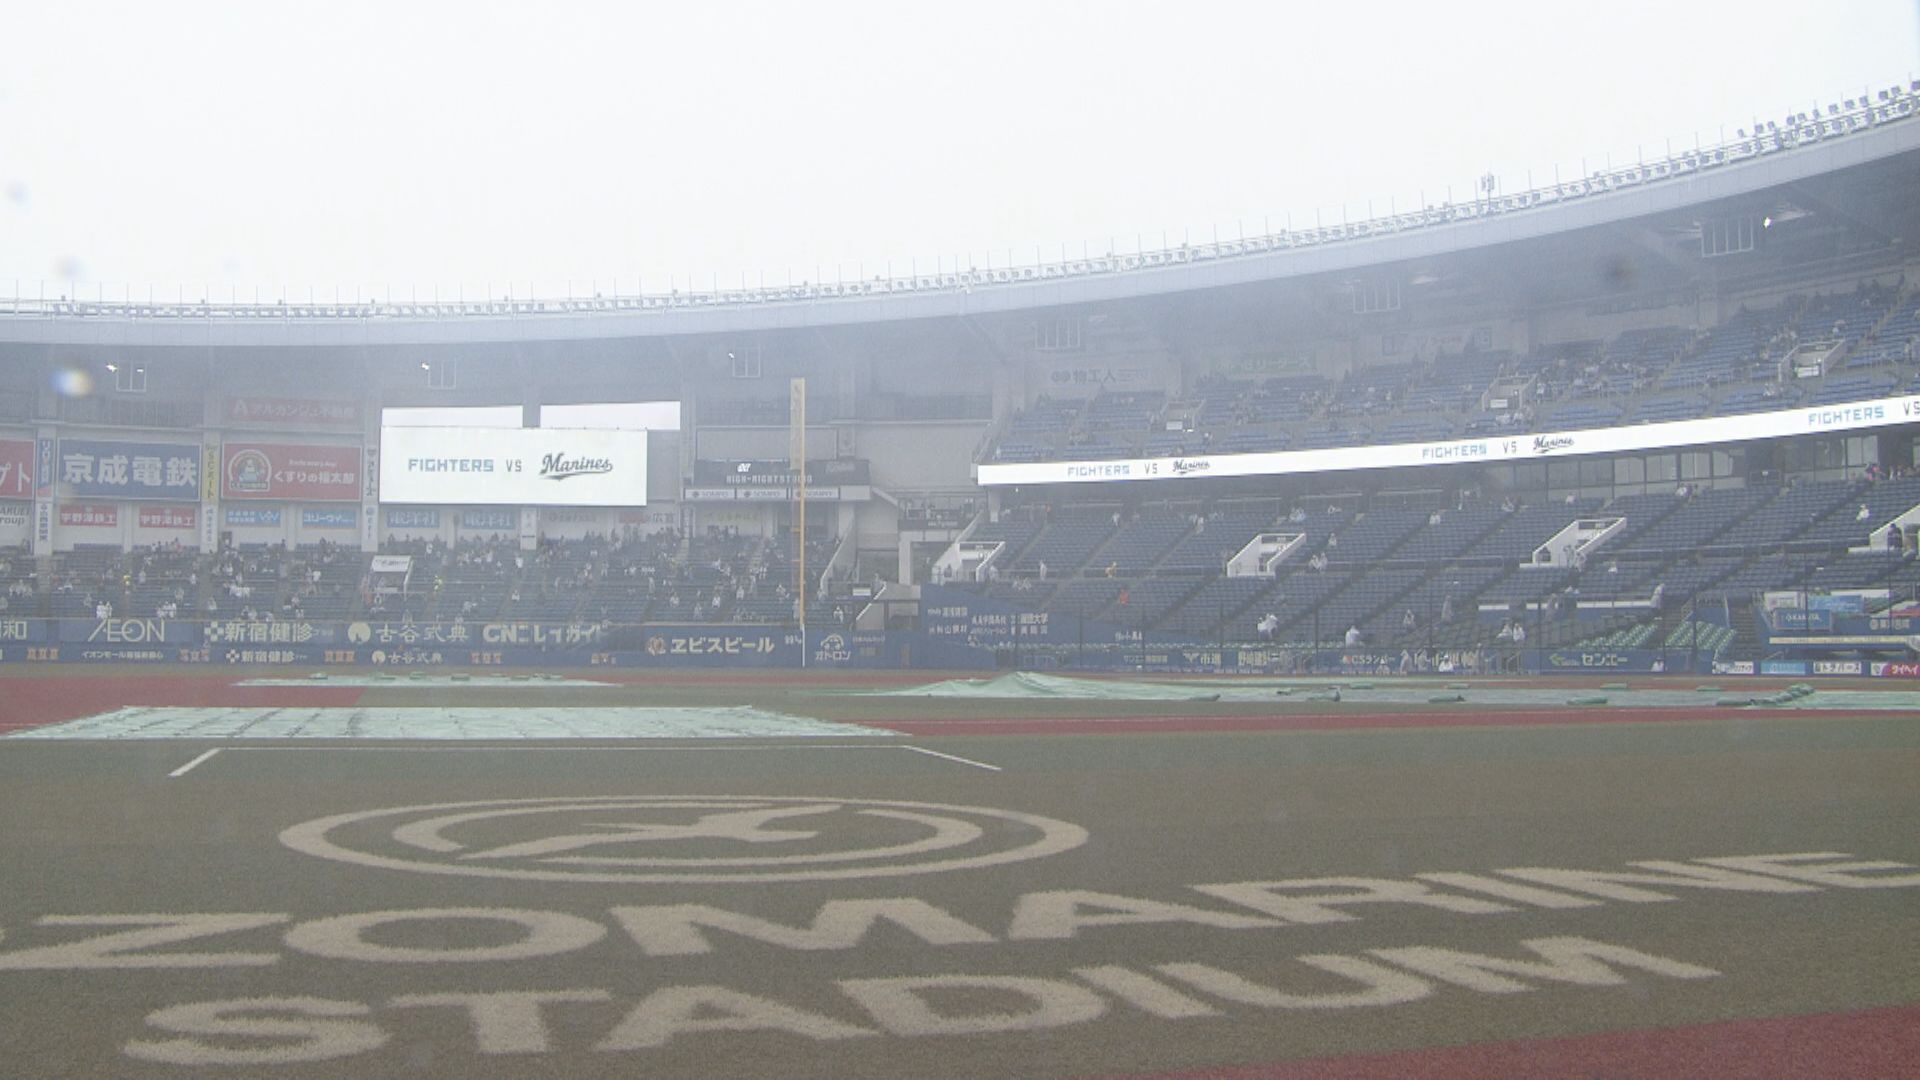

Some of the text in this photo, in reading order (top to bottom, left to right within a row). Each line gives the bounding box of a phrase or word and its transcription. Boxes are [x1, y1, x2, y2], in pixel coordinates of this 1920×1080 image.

[1808, 406, 1884, 425] FIGHTERS
[1422, 435, 1574, 459] FIGHTERS VS Marines
[63, 453, 196, 487] 京成電鉄
[408, 452, 613, 481] FIGHTERS VS Marines
[1067, 459, 1210, 477] FIGHTERS VS Marines
[274, 471, 355, 485] くすりの福太郎
[376, 623, 469, 643] 古谷式典
[124, 936, 1722, 1066] STADIUM
